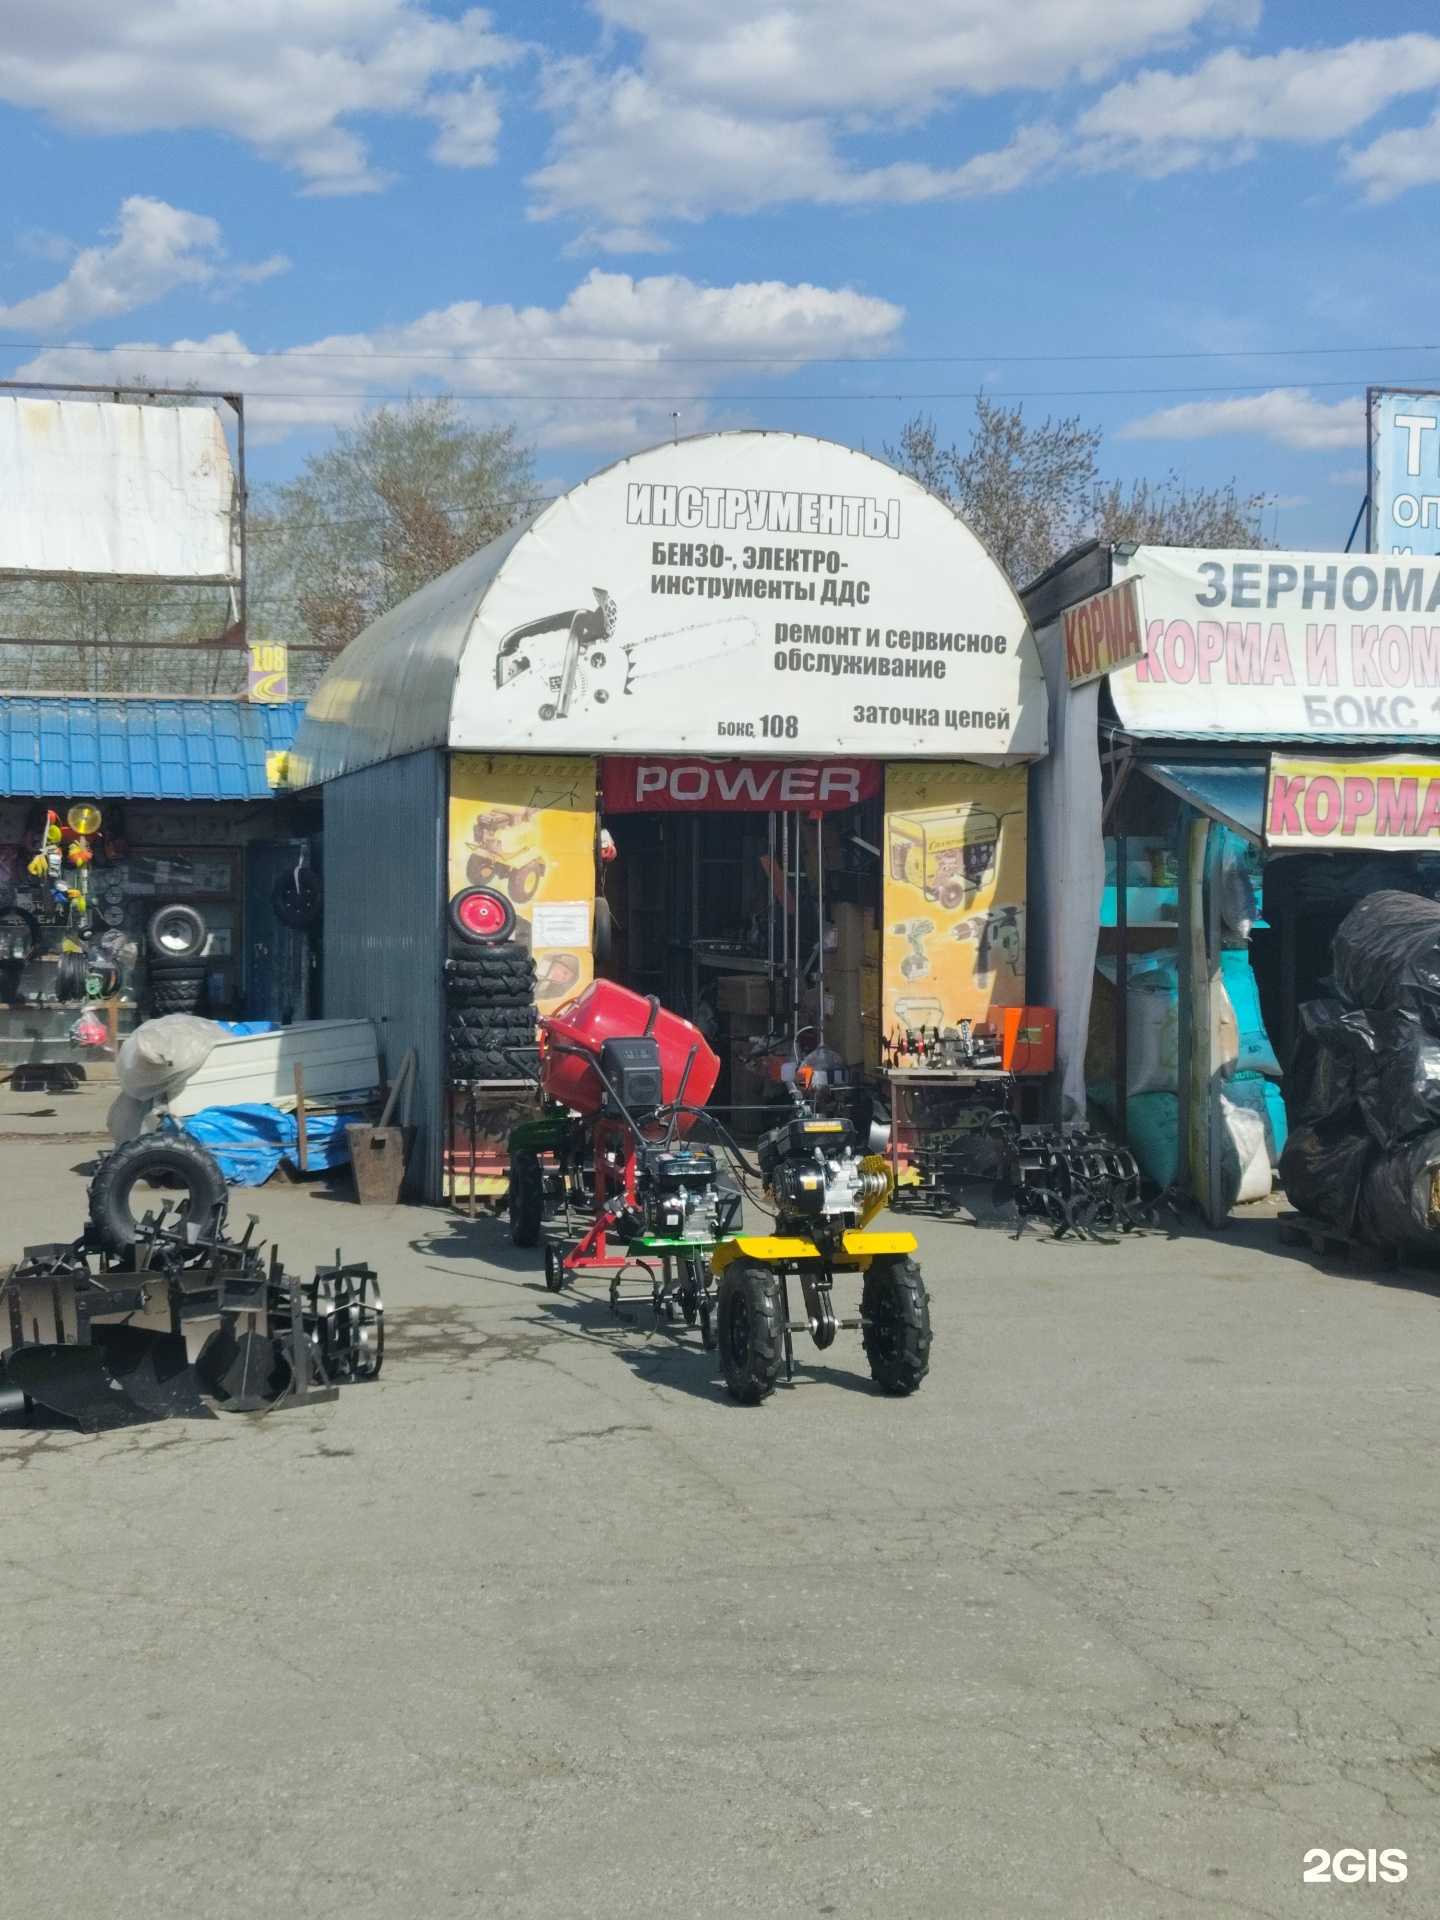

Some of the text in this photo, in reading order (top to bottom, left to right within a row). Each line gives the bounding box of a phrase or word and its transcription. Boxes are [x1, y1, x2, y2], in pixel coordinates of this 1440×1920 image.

[1394, 414, 1440, 477] Т
[626, 483, 900, 539] ИНСТРУМЕНТЫ
[651, 543, 849, 574] БЕНЗО-, ЭЛЕКТРО-
[650, 574, 871, 607] инструменты ДДС
[774, 622, 1008, 656] ремонт и сервисное
[1063, 583, 1138, 680] КОРМА
[774, 651, 947, 679] обслуживание
[1136, 619, 1440, 689] КОРМА И КОМ
[759, 714, 799, 739] 108
[853, 703, 1011, 733] заточка цепей
[1303, 695, 1418, 728] БОКС
[635, 766, 860, 802] POWER
[1268, 775, 1440, 837] КОРМА
